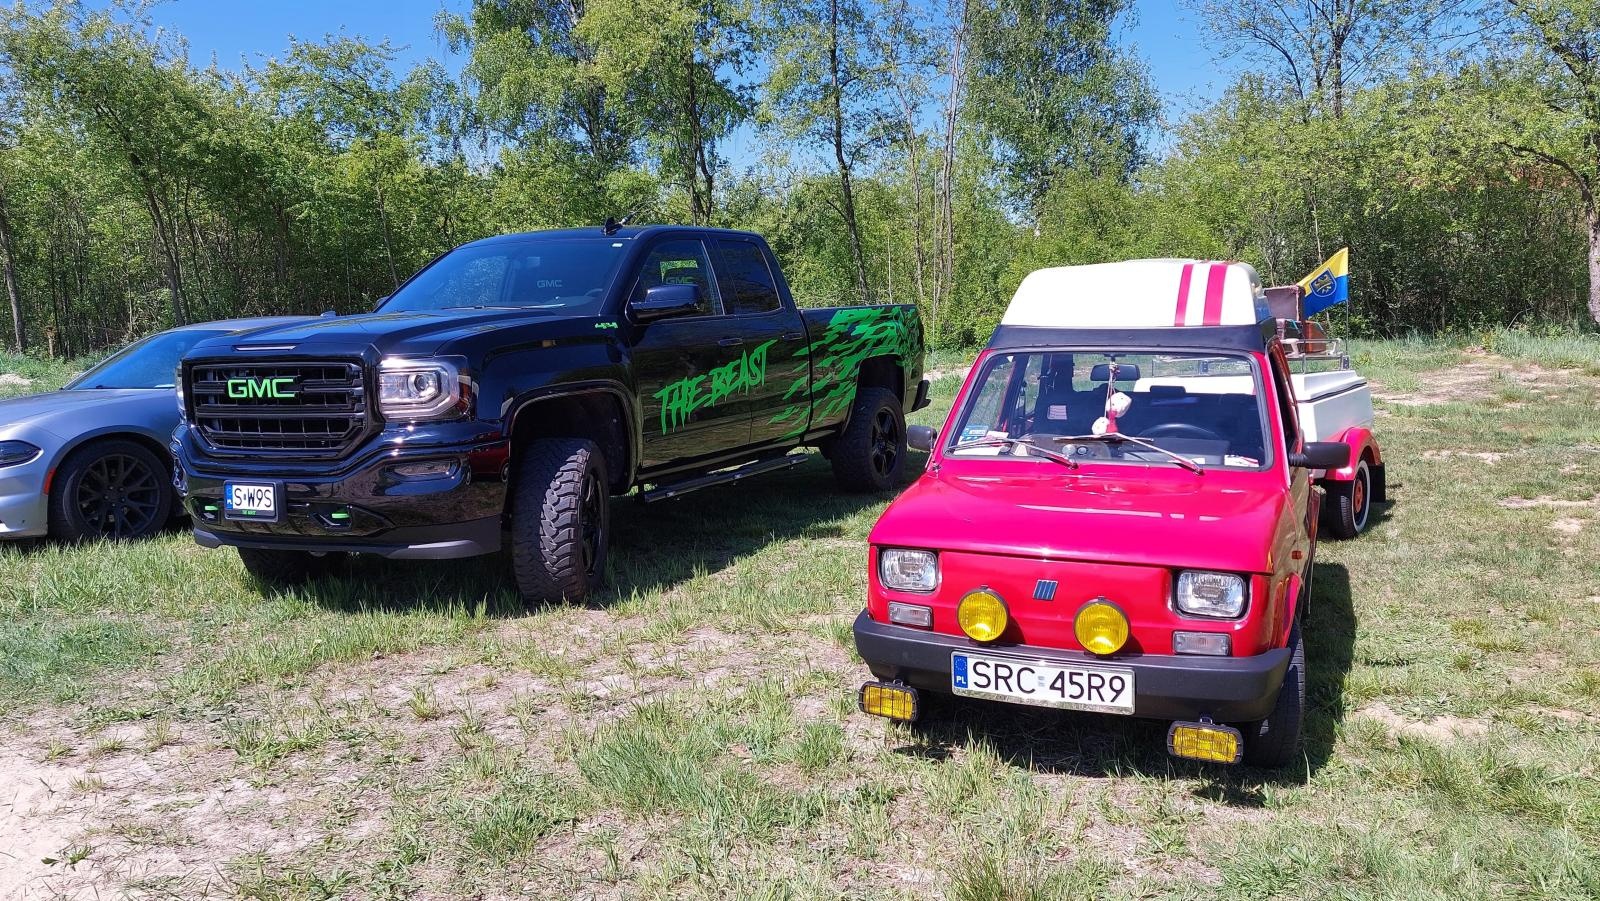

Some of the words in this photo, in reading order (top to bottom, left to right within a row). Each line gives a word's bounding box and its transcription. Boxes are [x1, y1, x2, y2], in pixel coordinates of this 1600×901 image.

[536, 279, 563, 288] GMC
[227, 378, 295, 398] GMC
[652, 374, 712, 435] THE
[703, 339, 779, 408] BEAST
[955, 675, 967, 685] PL
[972, 660, 1036, 695] SRC
[1048, 670, 1126, 703] 45R9
